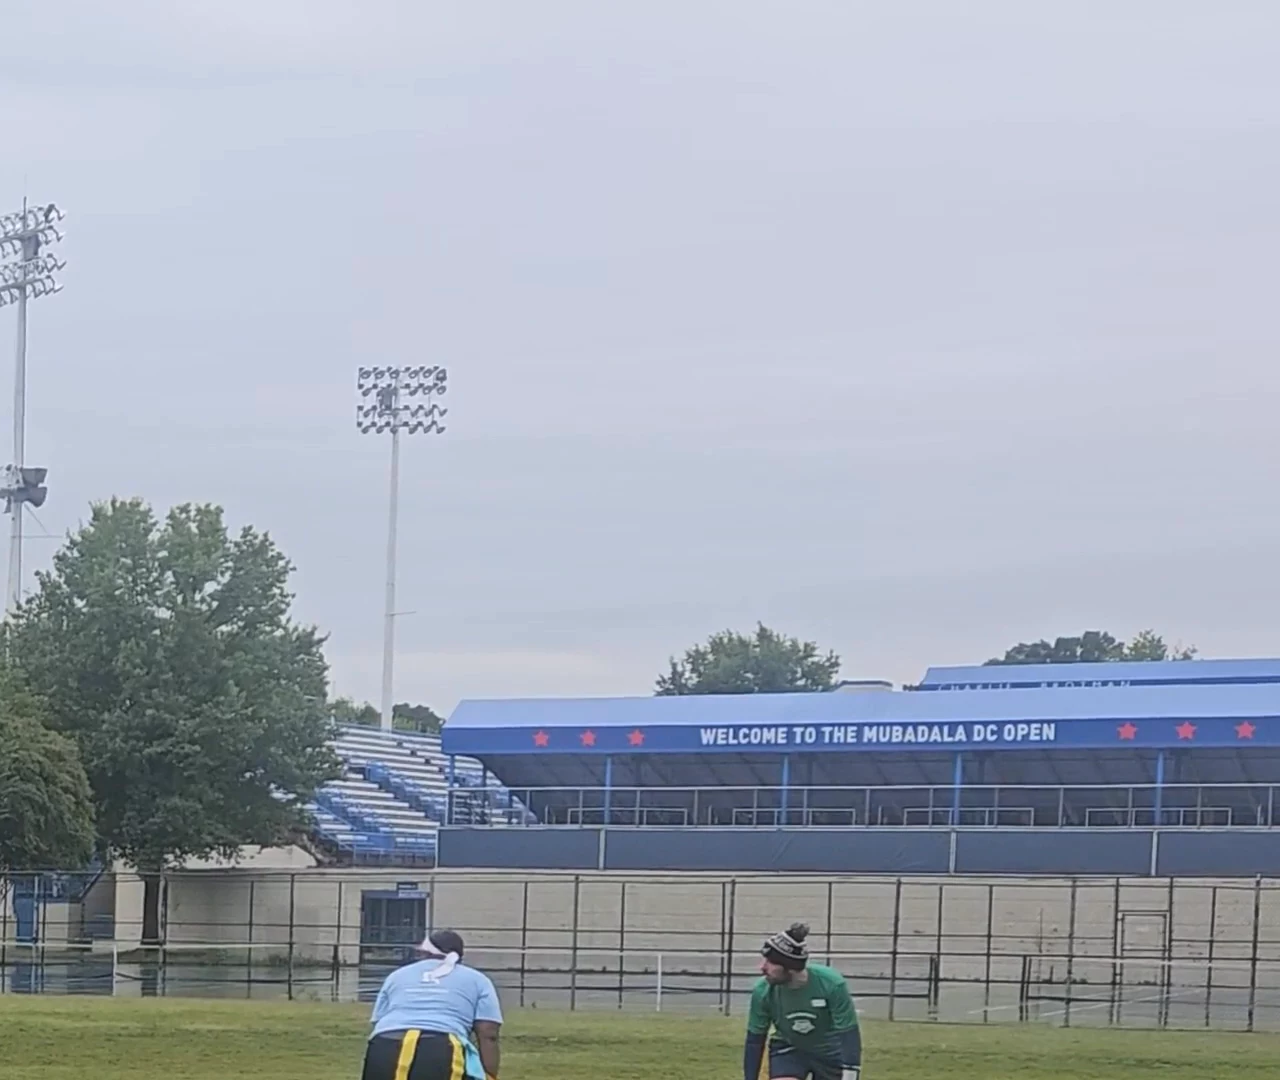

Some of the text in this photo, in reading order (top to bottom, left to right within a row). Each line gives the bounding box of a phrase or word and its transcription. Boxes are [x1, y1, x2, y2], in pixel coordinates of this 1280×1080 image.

[700, 723, 1056, 745] WELCOME TO THE MUBADALA DC OPEN
